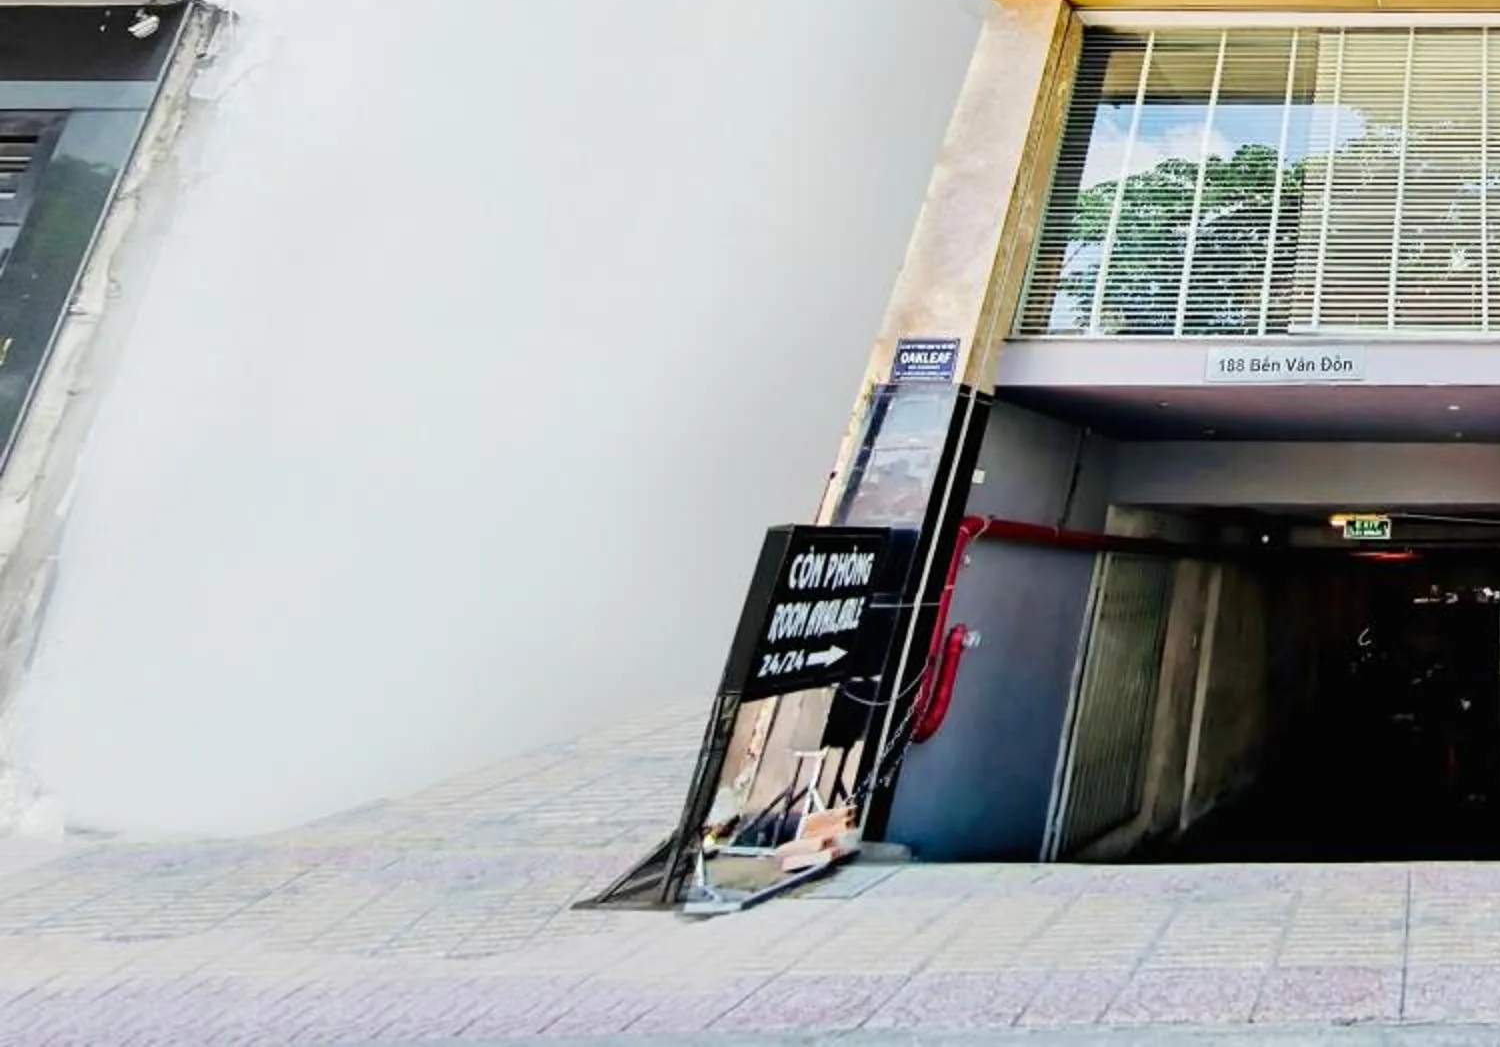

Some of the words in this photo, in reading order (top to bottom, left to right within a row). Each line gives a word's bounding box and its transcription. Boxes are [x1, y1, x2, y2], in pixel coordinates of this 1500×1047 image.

[900, 351, 953, 364] OAKLEAF
[1218, 357, 1245, 373] 188
[788, 544, 826, 590] CÒN
[822, 544, 876, 592] PHÒNG
[767, 600, 813, 644] ROOM
[756, 649, 806, 678] 24/24
